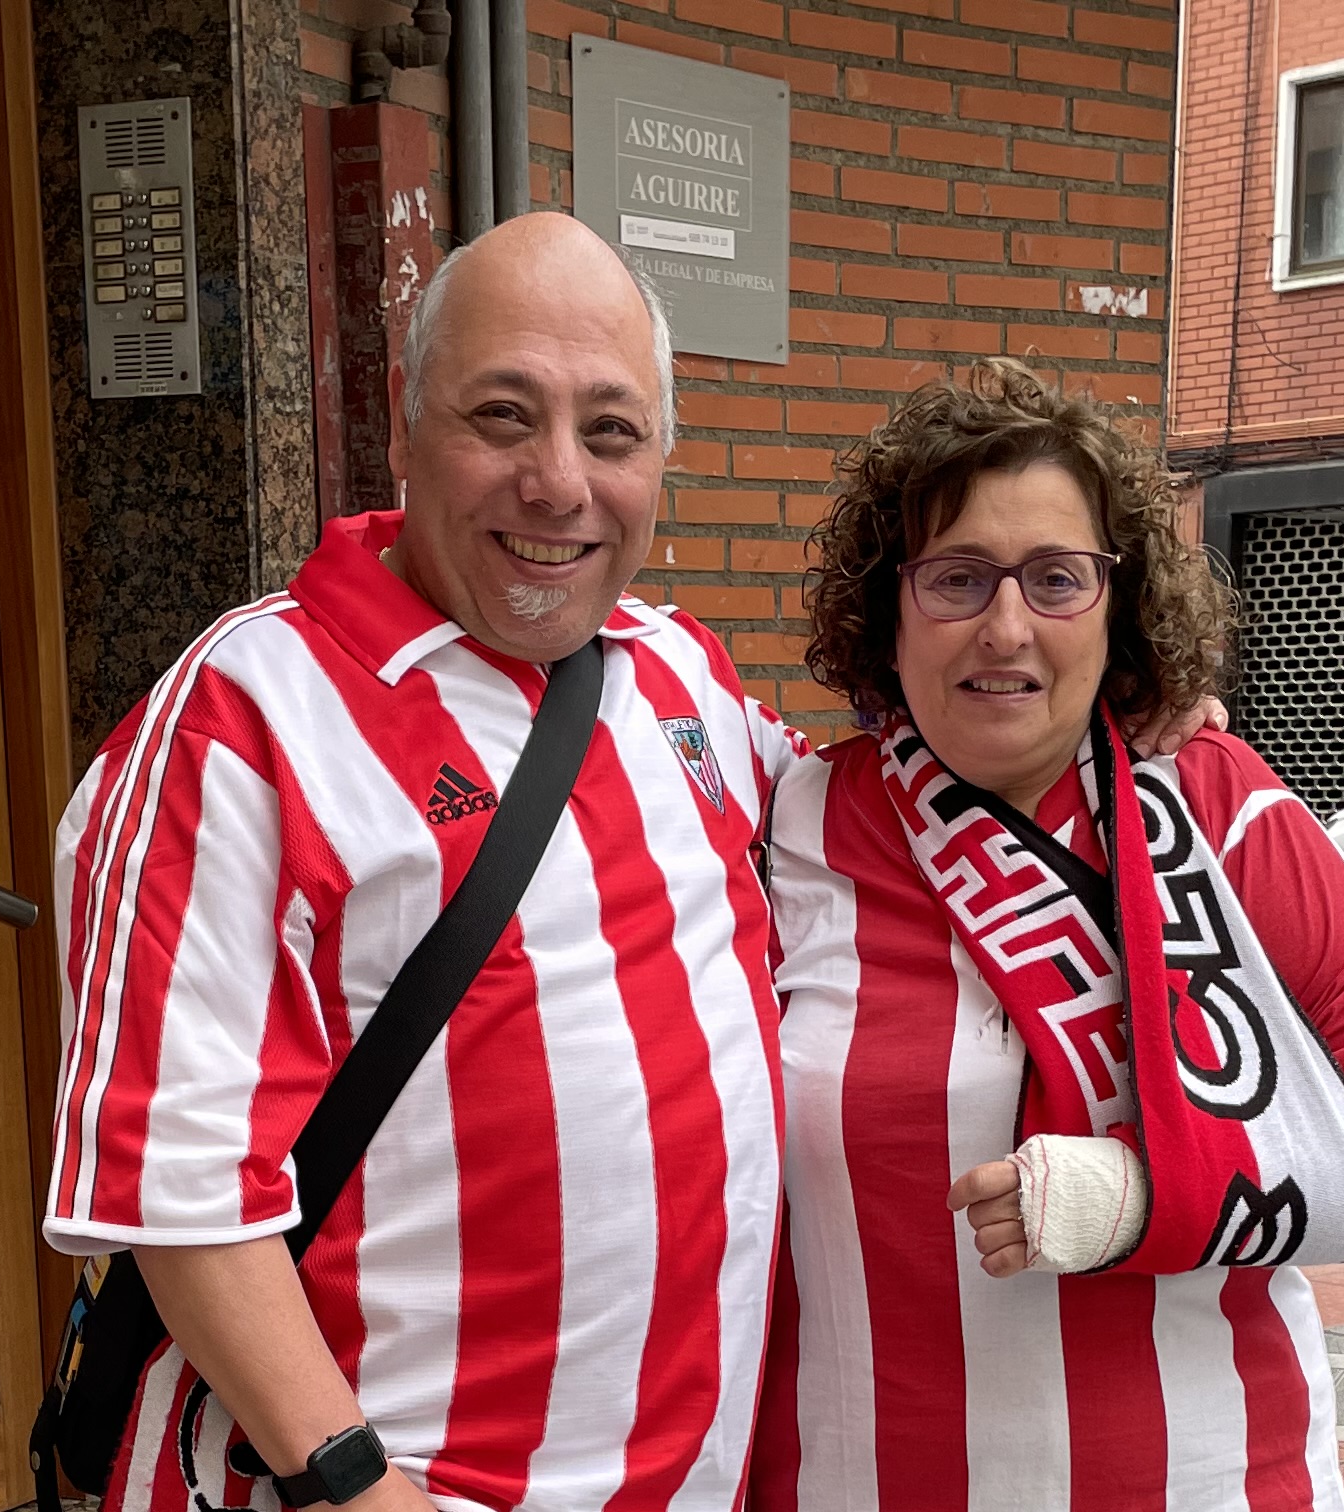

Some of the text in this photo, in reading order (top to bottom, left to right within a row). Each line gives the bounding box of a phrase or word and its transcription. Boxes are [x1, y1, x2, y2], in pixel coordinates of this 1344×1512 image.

[624, 116, 744, 166] ASESORIA
[630, 172, 740, 217] AGUIRRE
[654, 260, 775, 293] LEGAL Y DE EMPRESA
[425, 790, 498, 826] adidas
